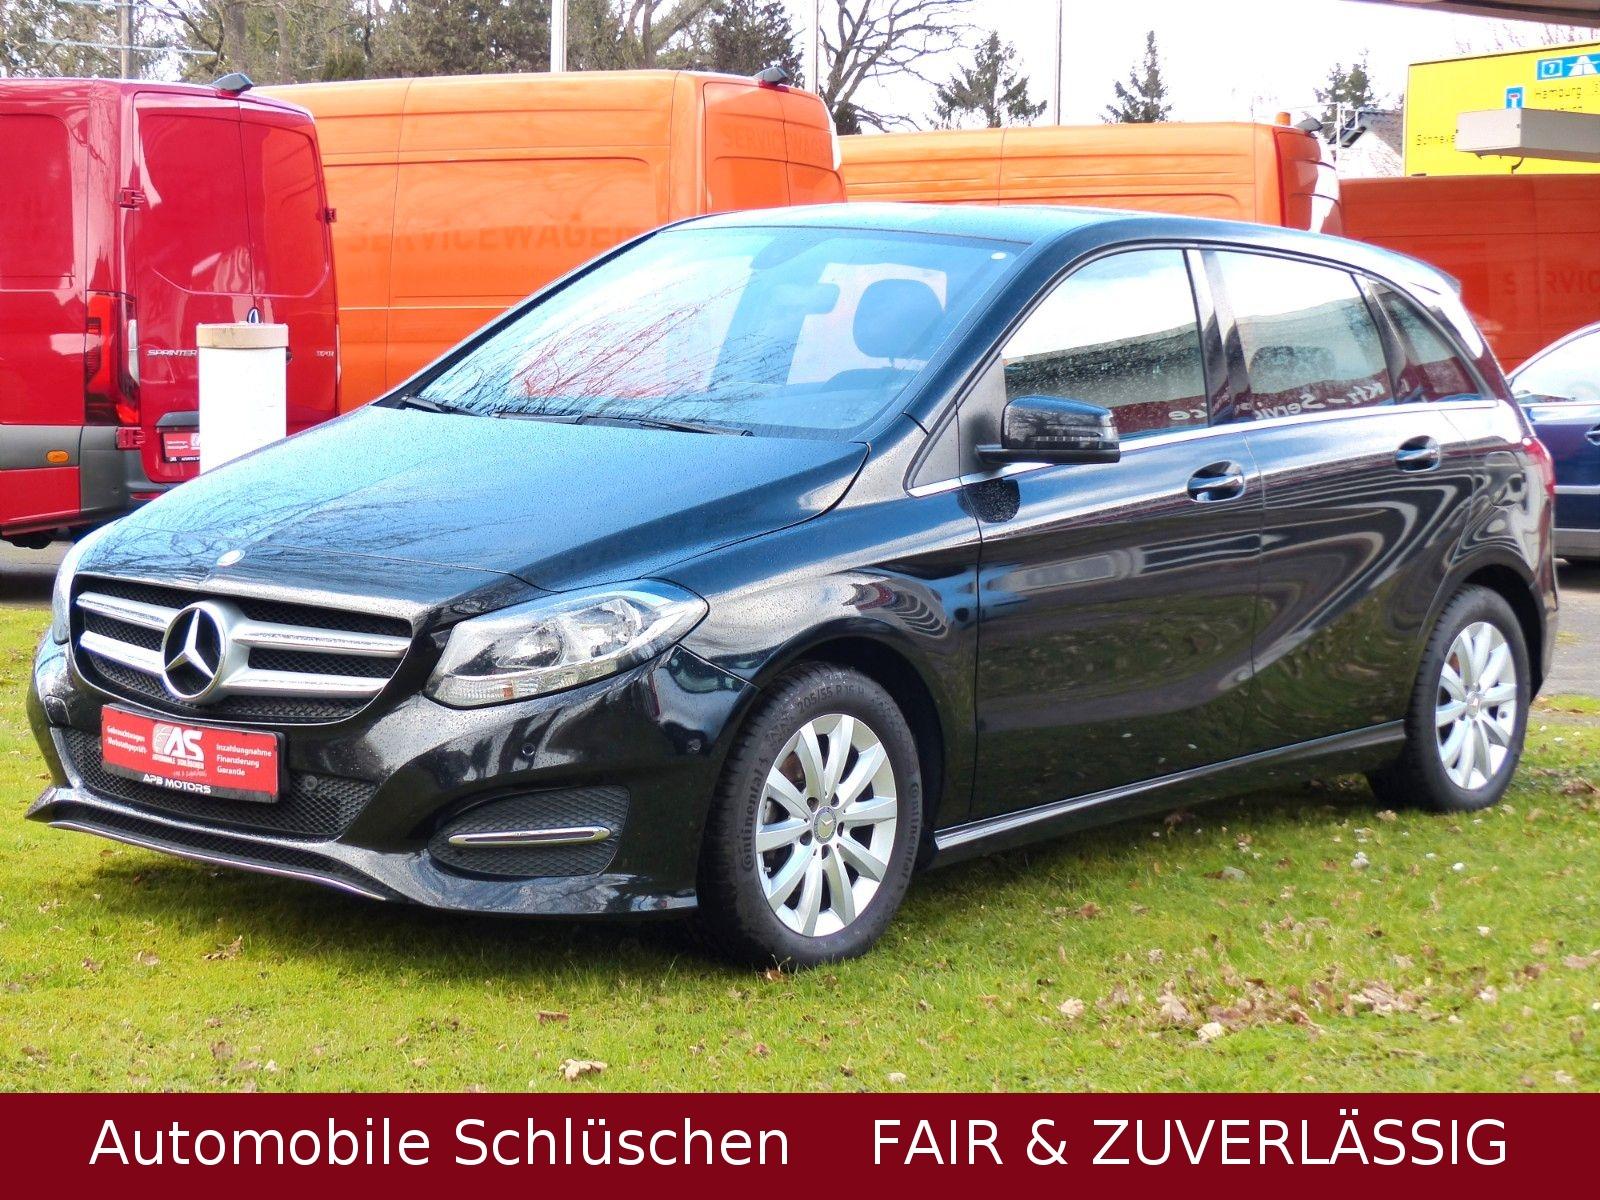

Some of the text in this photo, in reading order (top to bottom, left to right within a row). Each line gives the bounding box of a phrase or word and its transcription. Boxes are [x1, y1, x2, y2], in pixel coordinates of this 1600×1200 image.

[147, 349, 198, 357] SPRINTER
[163, 726, 205, 762] AS
[216, 744, 273, 757] Inzahlungnahme
[216, 754, 260, 768] Finanzierung
[217, 765, 246, 777] Garantie
[142, 773, 164, 785] APB
[165, 778, 212, 794] MOTORS
[740, 768, 764, 872] Continental
